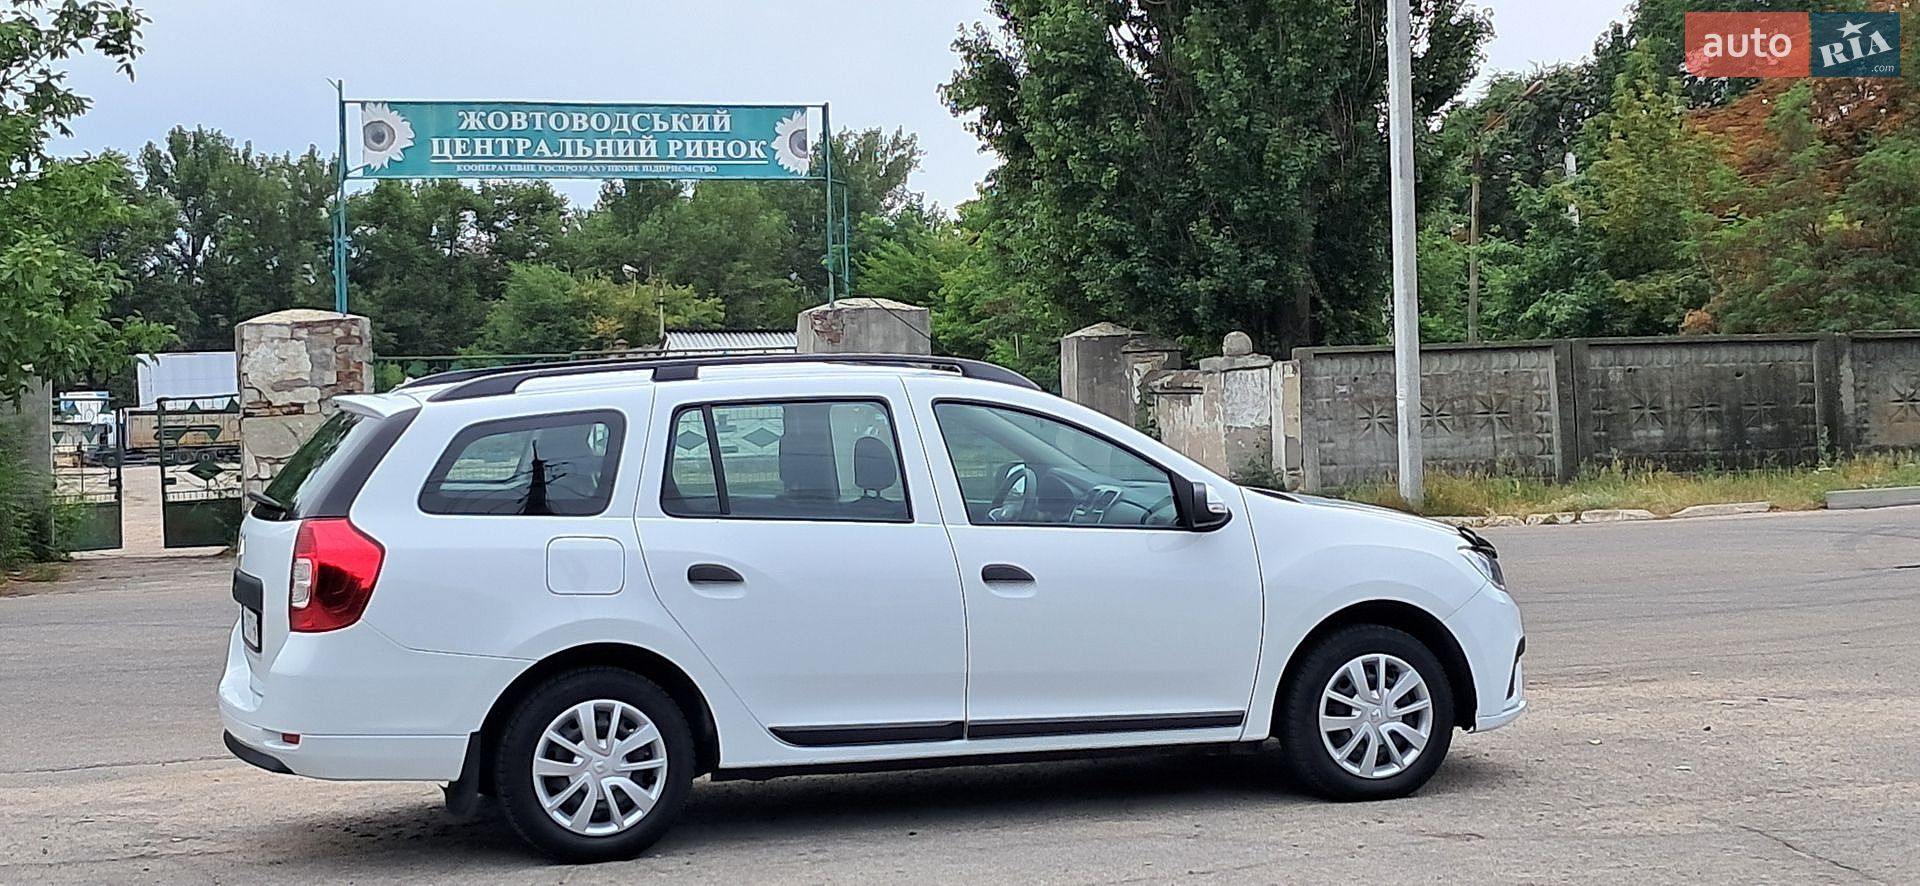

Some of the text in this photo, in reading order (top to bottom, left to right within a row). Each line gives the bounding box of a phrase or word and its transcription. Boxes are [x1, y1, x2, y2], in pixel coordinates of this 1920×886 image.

[458, 109, 731, 135] ЖОВТОВОДСЬКИЙ
[430, 135, 768, 160] ЦЕНТРАЛЬНИЙ РИНОК
